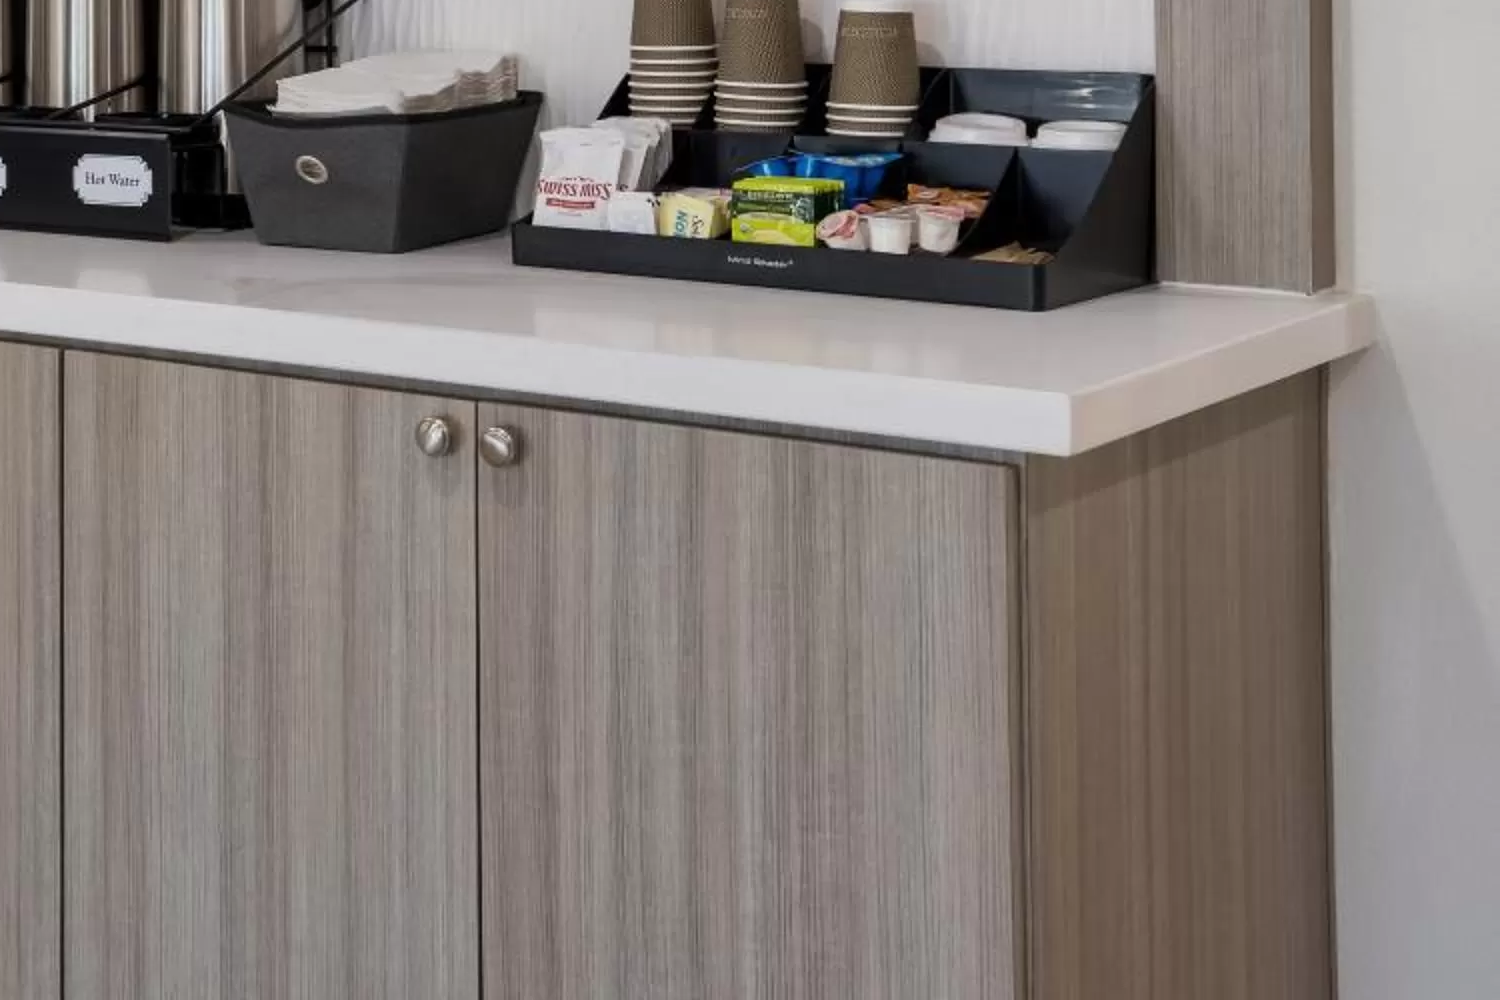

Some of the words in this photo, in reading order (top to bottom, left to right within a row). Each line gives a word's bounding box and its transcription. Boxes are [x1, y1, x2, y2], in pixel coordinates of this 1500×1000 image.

[85, 171, 105, 185] Hot
[108, 172, 140, 187] Water
[579, 183, 612, 201] MISS
